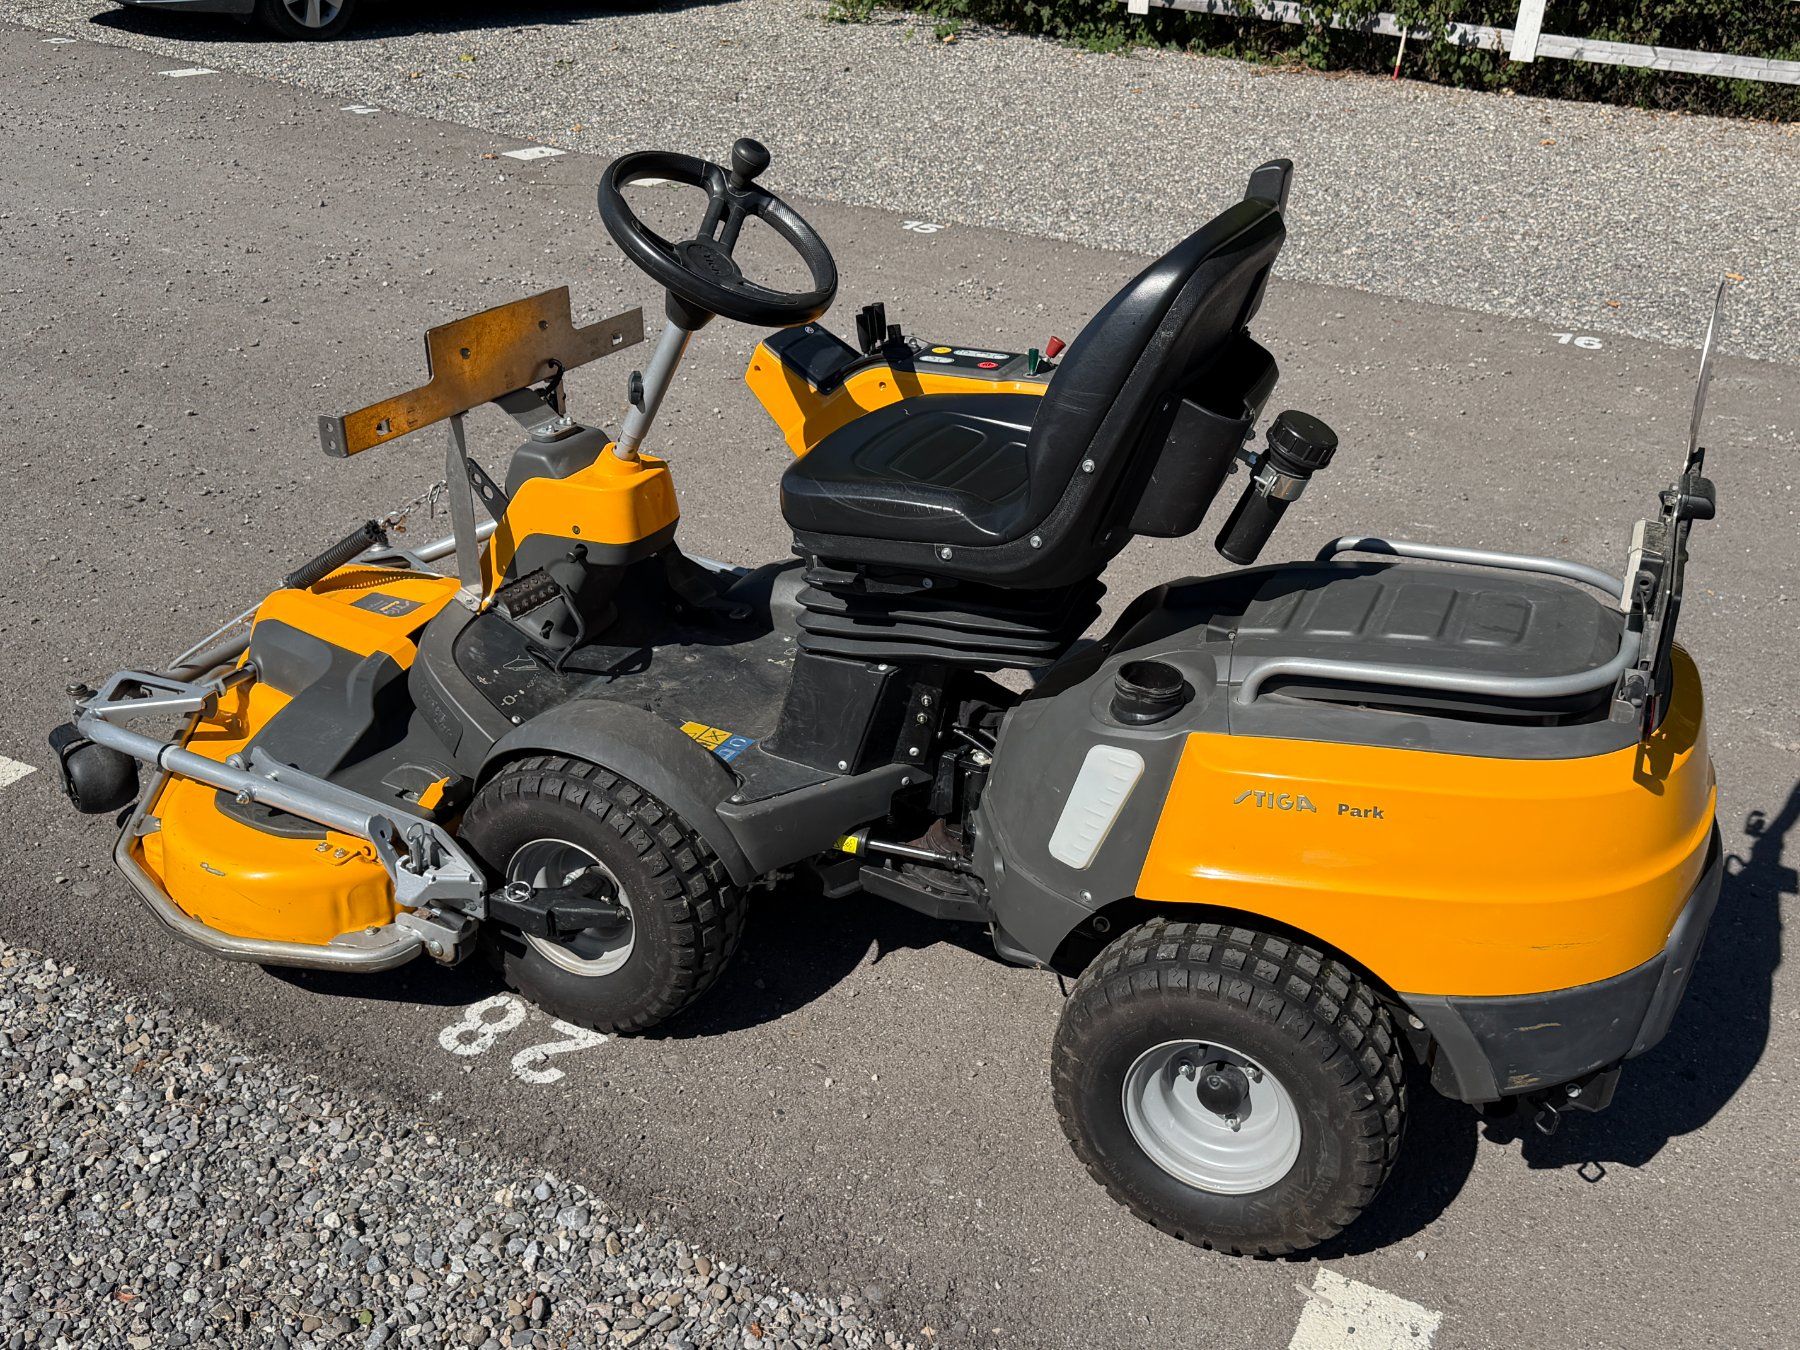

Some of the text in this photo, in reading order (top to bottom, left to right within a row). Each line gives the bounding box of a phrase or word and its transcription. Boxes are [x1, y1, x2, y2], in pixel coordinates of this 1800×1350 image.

[902, 220, 945, 233] 15
[1552, 332, 1603, 350] 16
[1234, 789, 1385, 819] STIGA Park
[438, 994, 609, 1084] 28
